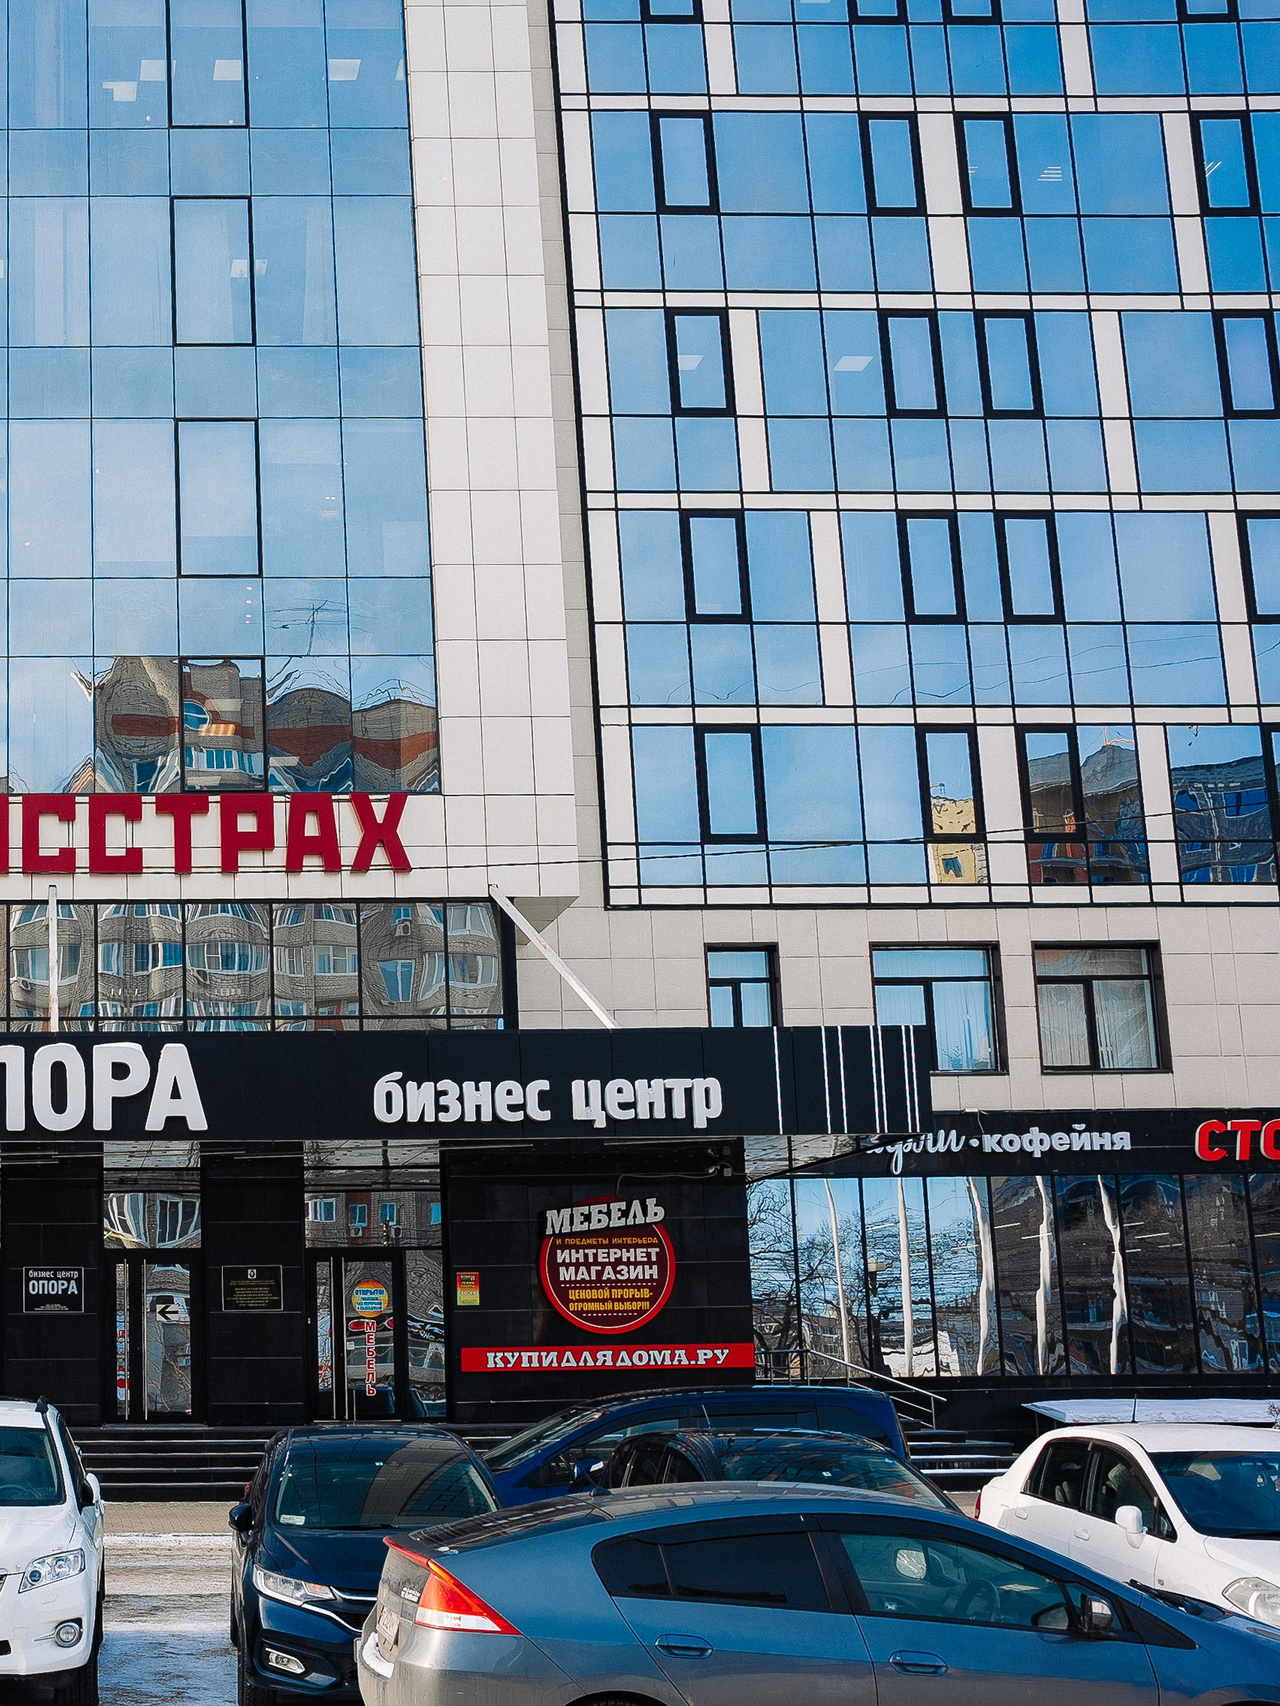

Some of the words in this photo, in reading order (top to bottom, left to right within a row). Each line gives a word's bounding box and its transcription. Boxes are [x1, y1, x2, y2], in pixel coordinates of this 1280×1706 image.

[374, 1071, 551, 1123] бизнес
[571, 1077, 722, 1128] центр
[982, 1123, 1131, 1157] кофейня
[545, 1197, 665, 1235] МЕБЕЛЬ
[612, 1237, 659, 1245] ИНТЕРЬЕРА
[556, 1247, 660, 1263] ИНТЕРНЕТ
[28, 1269, 54, 1278] бизнес
[56, 1270, 79, 1279] центр
[559, 1264, 658, 1281] МАГАЗИН
[28, 1279, 78, 1295] ОПОРА
[568, 1287, 610, 1300] ЦЕНОВОЙ
[569, 1300, 613, 1311] ОГРОМНЫЙ
[364, 1321, 376, 1396] МЕБЕЛЬ
